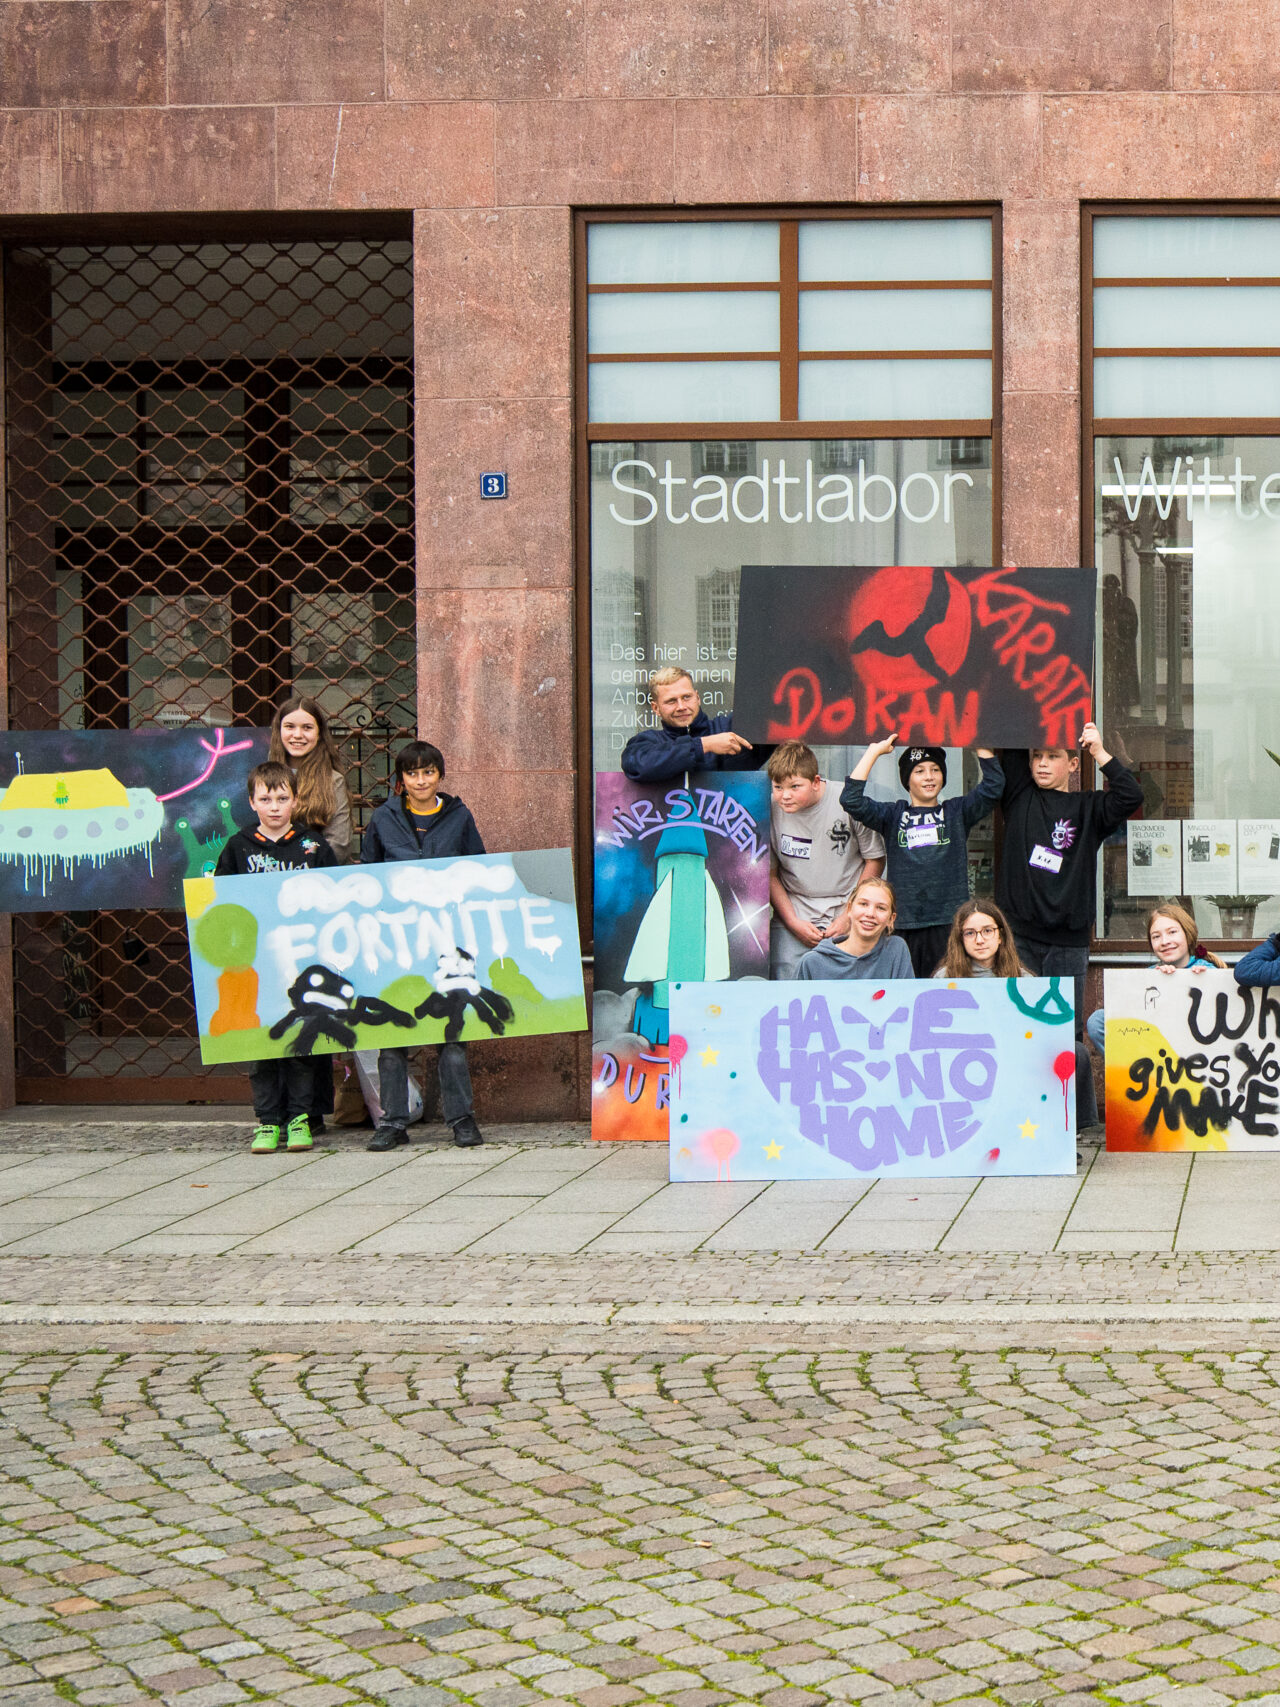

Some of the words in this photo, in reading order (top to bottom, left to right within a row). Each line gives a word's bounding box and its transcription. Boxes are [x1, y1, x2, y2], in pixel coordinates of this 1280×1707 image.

[487, 475, 500, 494] 3
[609, 458, 973, 525] Stadtlabor
[610, 643, 645, 661] Das
[653, 643, 687, 661] hier
[696, 643, 718, 661] ist
[968, 567, 1093, 748] KARATE
[702, 692, 724, 705] an
[665, 788, 767, 864] STARTEN
[901, 807, 945, 826] STAY
[268, 896, 562, 977] FORTNITE
[596, 1052, 670, 1110] DUR
[757, 1048, 866, 1105] HAS
[896, 1049, 998, 1103] NO
[1126, 1049, 1231, 1101] gives
[799, 1101, 983, 1171] HOME
